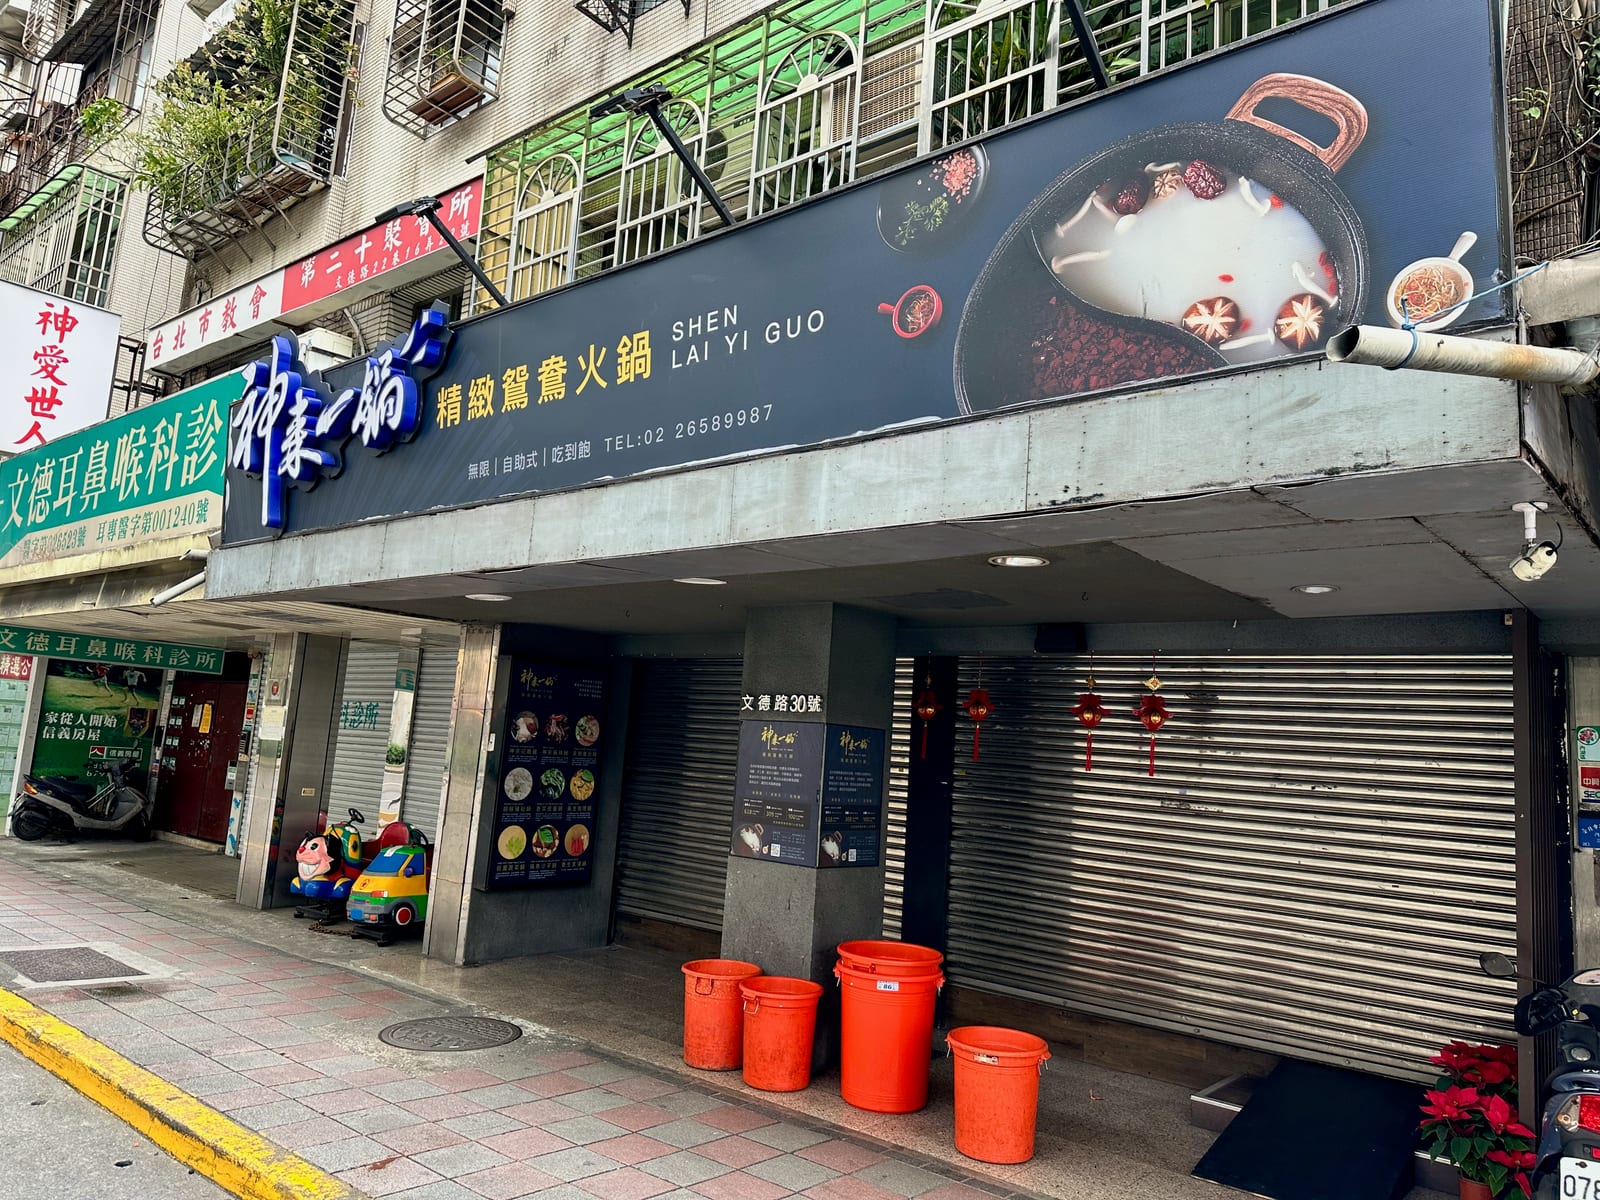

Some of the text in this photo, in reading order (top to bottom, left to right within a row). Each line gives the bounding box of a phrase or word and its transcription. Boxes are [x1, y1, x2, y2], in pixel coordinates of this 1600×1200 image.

[153, 284, 267, 360] 台北市教會
[672, 304, 738, 342] SHEN
[672, 309, 825, 369] LAI YI GUO
[13, 302, 79, 444] 神愛世人
[436, 329, 652, 429] 精緻鴛鴦火鍋
[675, 404, 773, 439] 26589987
[1, 399, 225, 533] 文德耳鼻喉科診
[0, 628, 217, 670] 文德耳鼻喉科診所
[44, 711, 118, 728] 家從人開始
[741, 694, 823, 713] 文德路30號
[42, 726, 101, 741] 信義房屋
